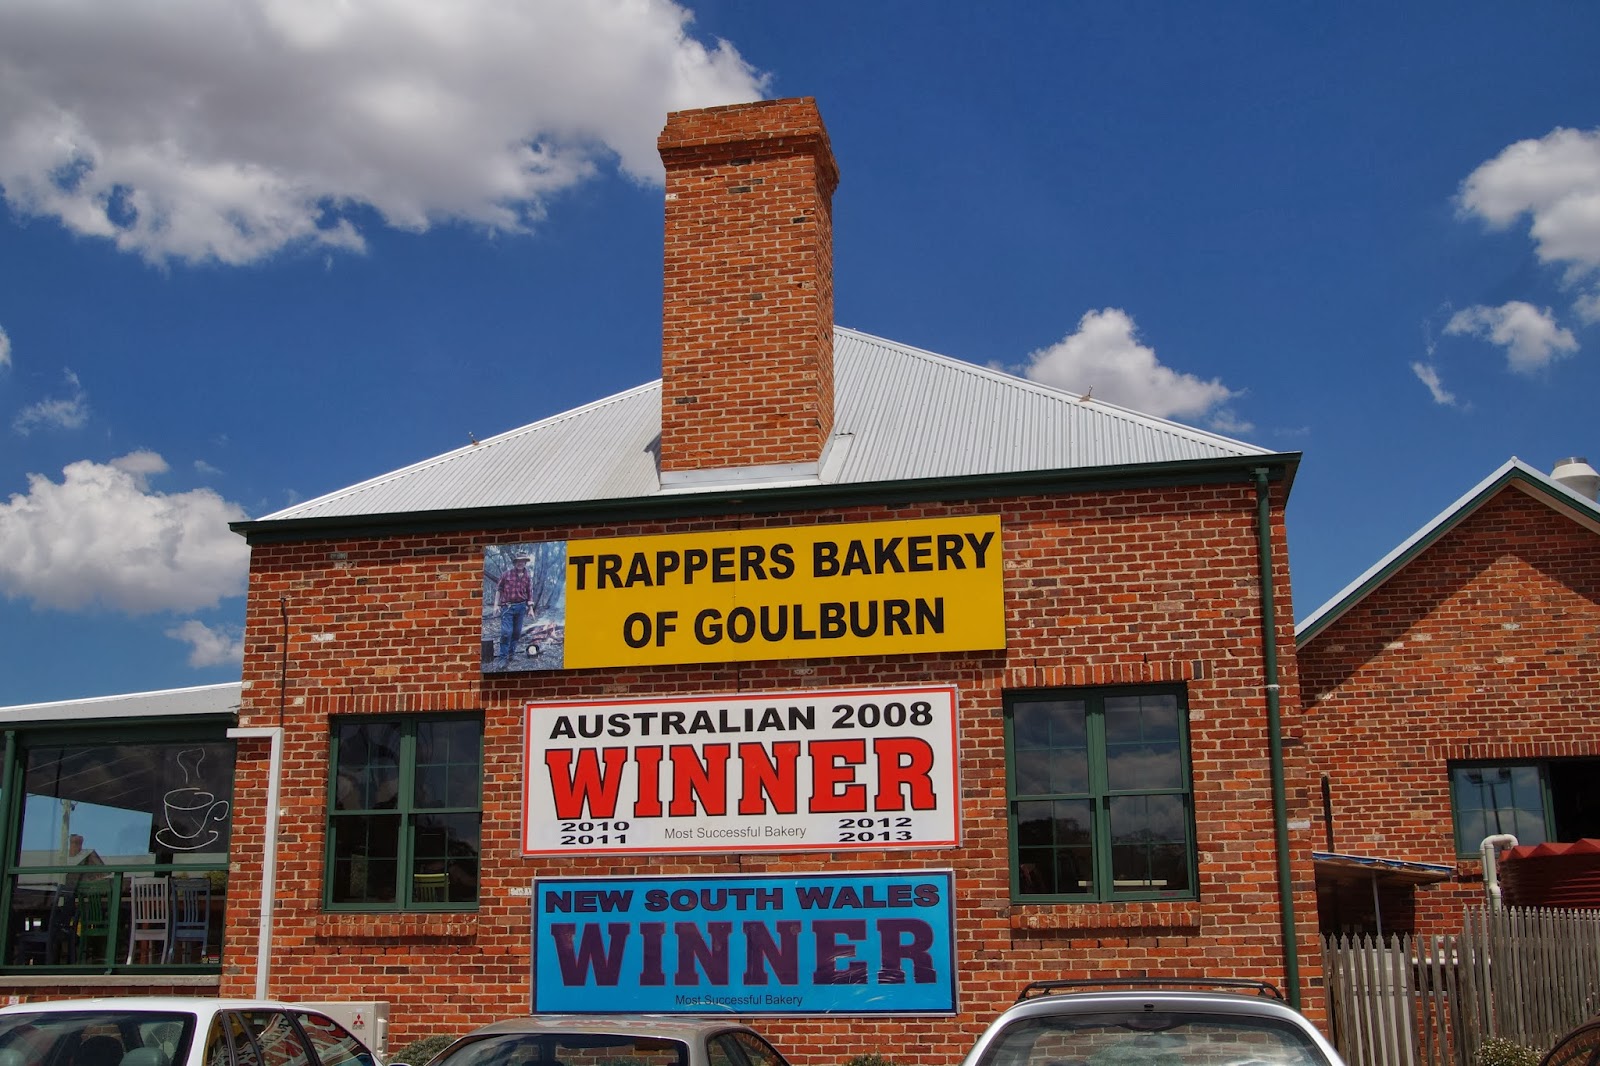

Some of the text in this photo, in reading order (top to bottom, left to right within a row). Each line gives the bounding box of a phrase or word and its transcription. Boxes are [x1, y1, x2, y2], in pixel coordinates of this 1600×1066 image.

[569, 531, 995, 590] TRAPPERS BAKERY
[623, 597, 945, 648] OF GOULBURN
[549, 701, 933, 739] AUSTRALIAN 2008
[545, 736, 937, 820] WINNER
[560, 821, 630, 832] 2010
[664, 825, 807, 840] Most Successful Bakery
[838, 817, 913, 829] 2012
[560, 834, 628, 845] 2011
[838, 831, 913, 843] 2013
[545, 884, 940, 913] NEW SOUTH WALES
[550, 918, 938, 986] WINNER
[675, 994, 803, 1007] Most Successful Bakery
